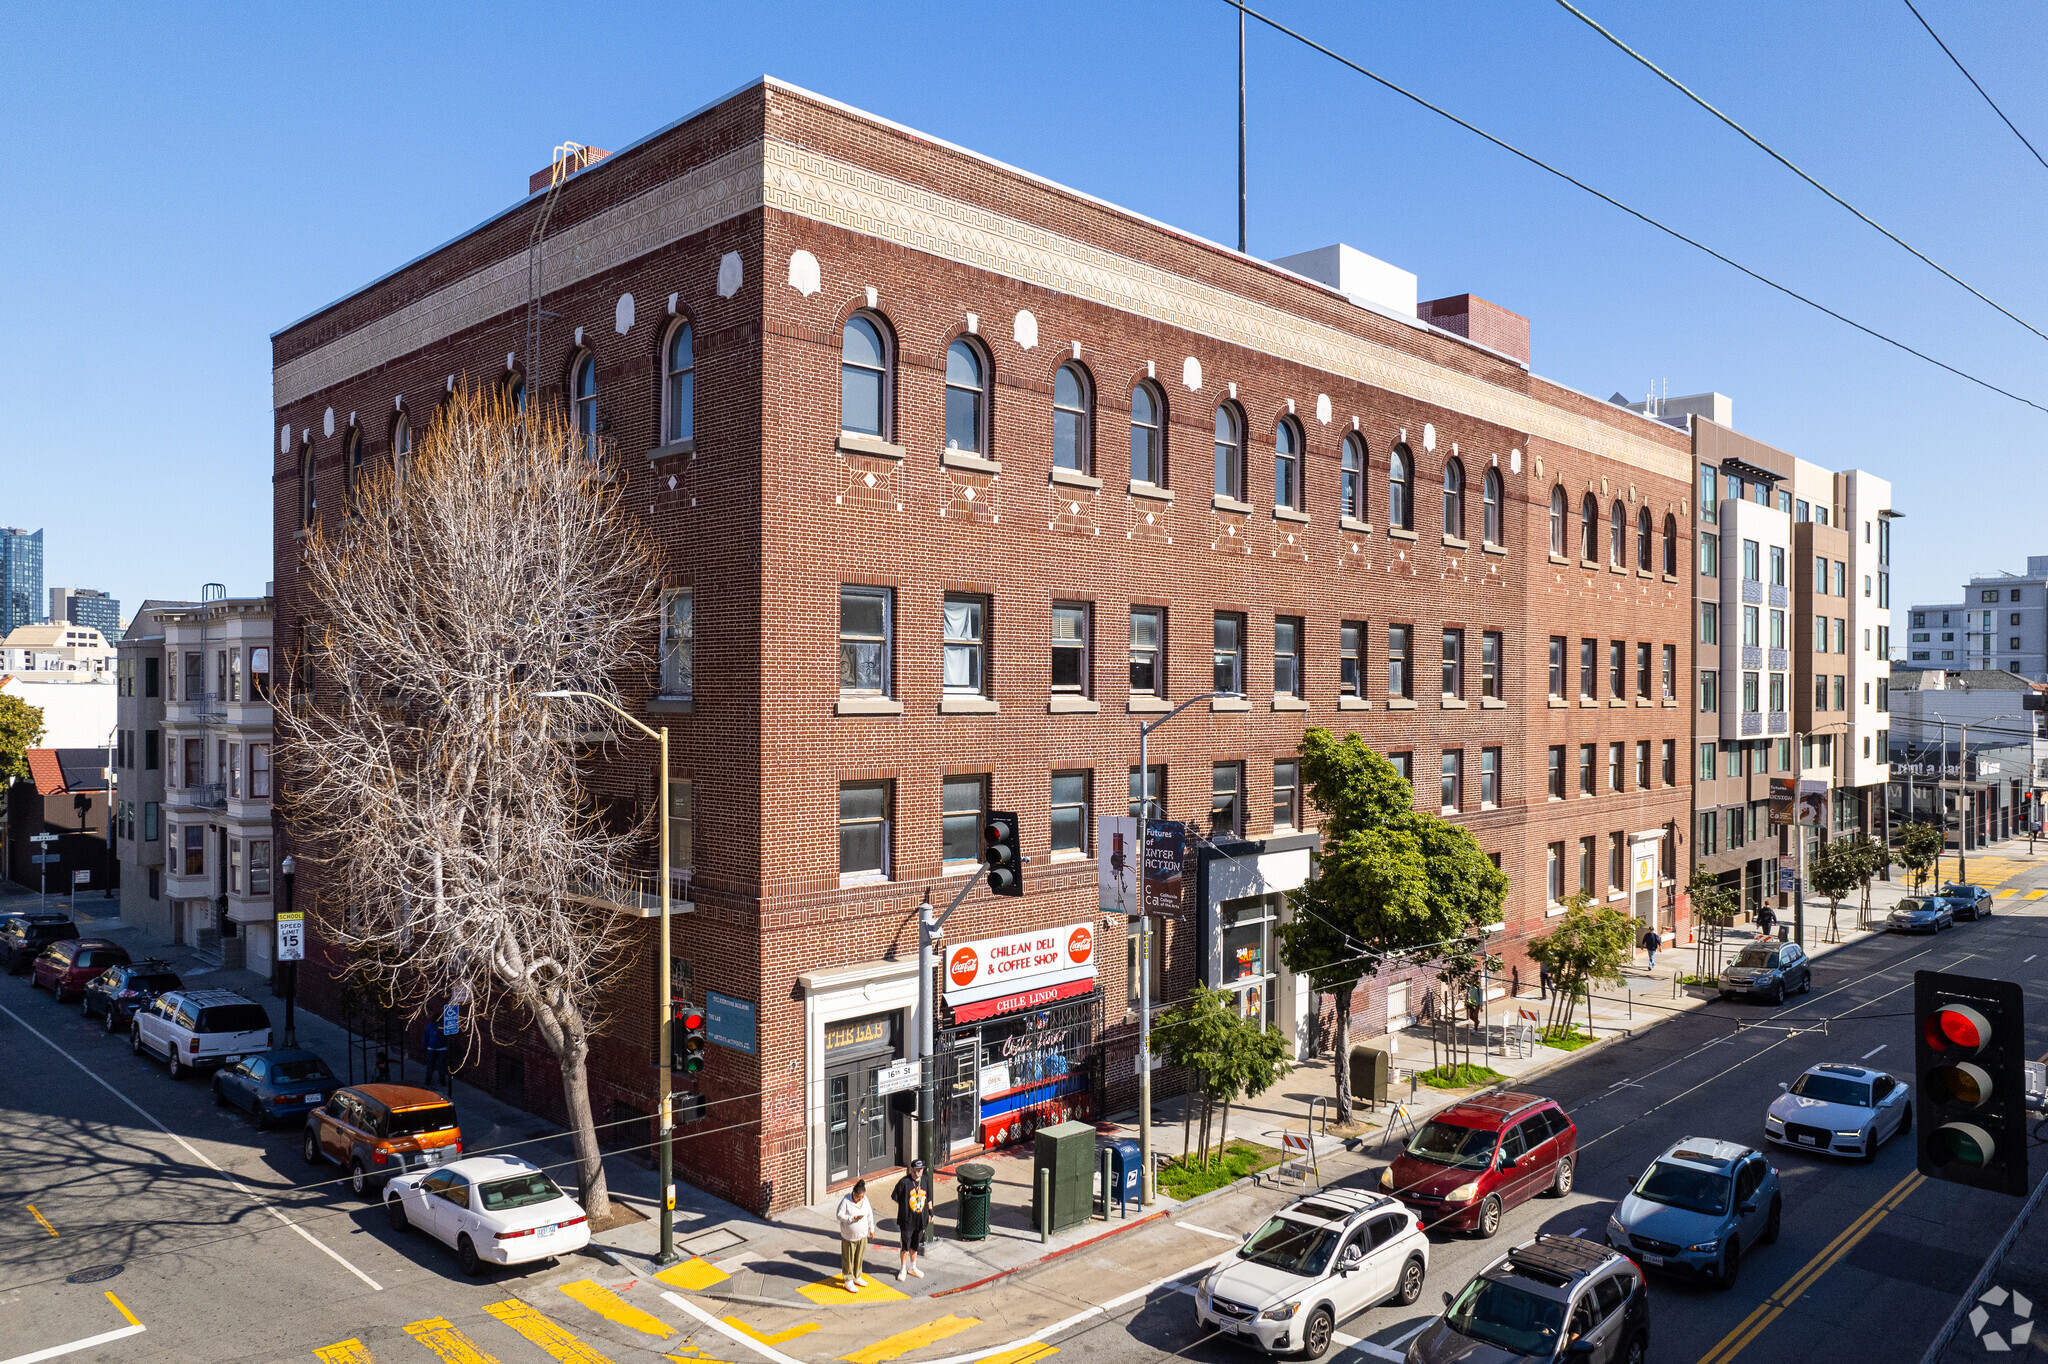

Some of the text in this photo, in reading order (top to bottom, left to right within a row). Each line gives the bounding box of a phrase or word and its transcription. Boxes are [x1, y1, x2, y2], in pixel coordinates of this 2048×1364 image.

[1926, 764, 1934, 774] a
[1888, 785, 1927, 799] MNI
[1146, 828, 1172, 838] Futures
[1146, 848, 1174, 860] INTER
[1145, 859, 1180, 871] ACTION
[1145, 885, 1152, 894] C
[283, 935, 299, 946] 15
[1069, 937, 1092, 953] Coca-Cola
[990, 938, 1055, 959] CHILEAN DELI
[951, 958, 978, 974] Coca-Cola
[987, 952, 1058, 975] & COFFEE SHOP
[997, 989, 1057, 1011] CHILE LINDO
[824, 1022, 883, 1049] THE LAB
[888, 1067, 910, 1078] 16th St
